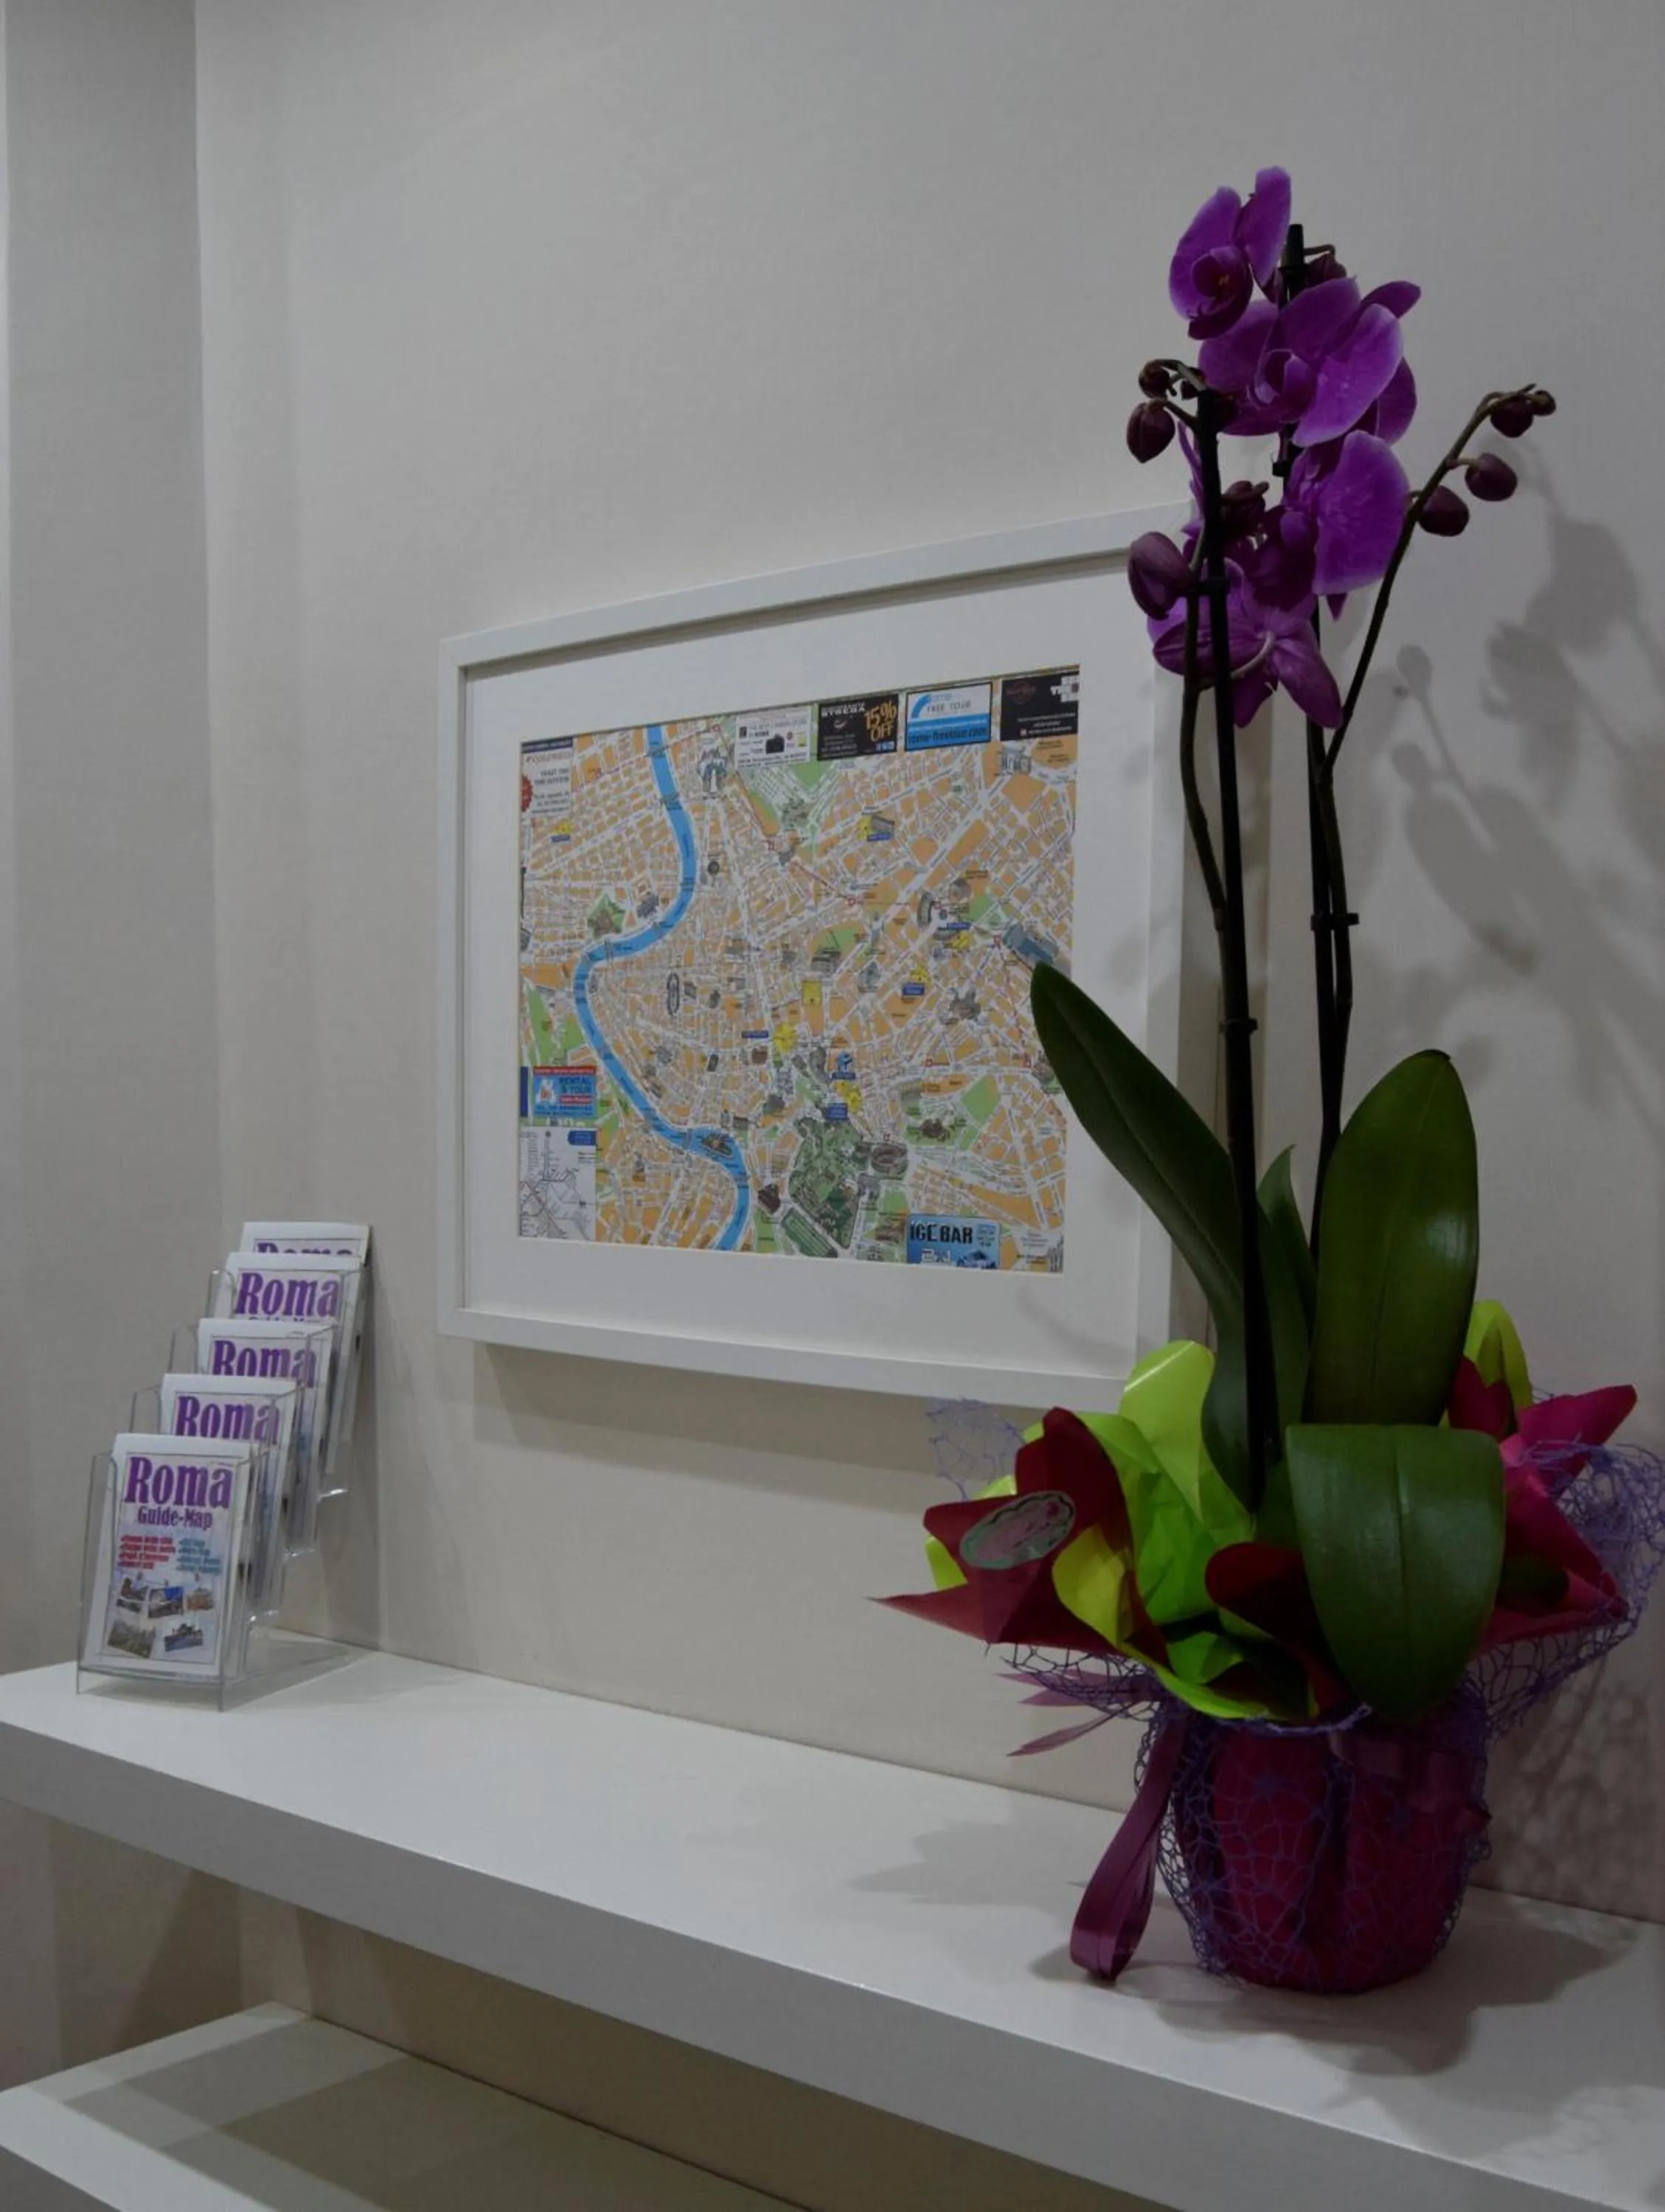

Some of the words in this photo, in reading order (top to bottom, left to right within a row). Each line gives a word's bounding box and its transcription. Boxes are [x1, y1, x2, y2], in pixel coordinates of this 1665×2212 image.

[863, 700, 897, 731] 15%
[870, 722, 895, 742] OFF
[940, 1225, 973, 1244] BAR
[235, 1272, 339, 1318] Roma
[212, 1340, 317, 1389] Roma
[175, 1395, 279, 1446] Roma
[124, 1456, 234, 1509] Roma
[137, 1506, 213, 1531] Guide-Map
